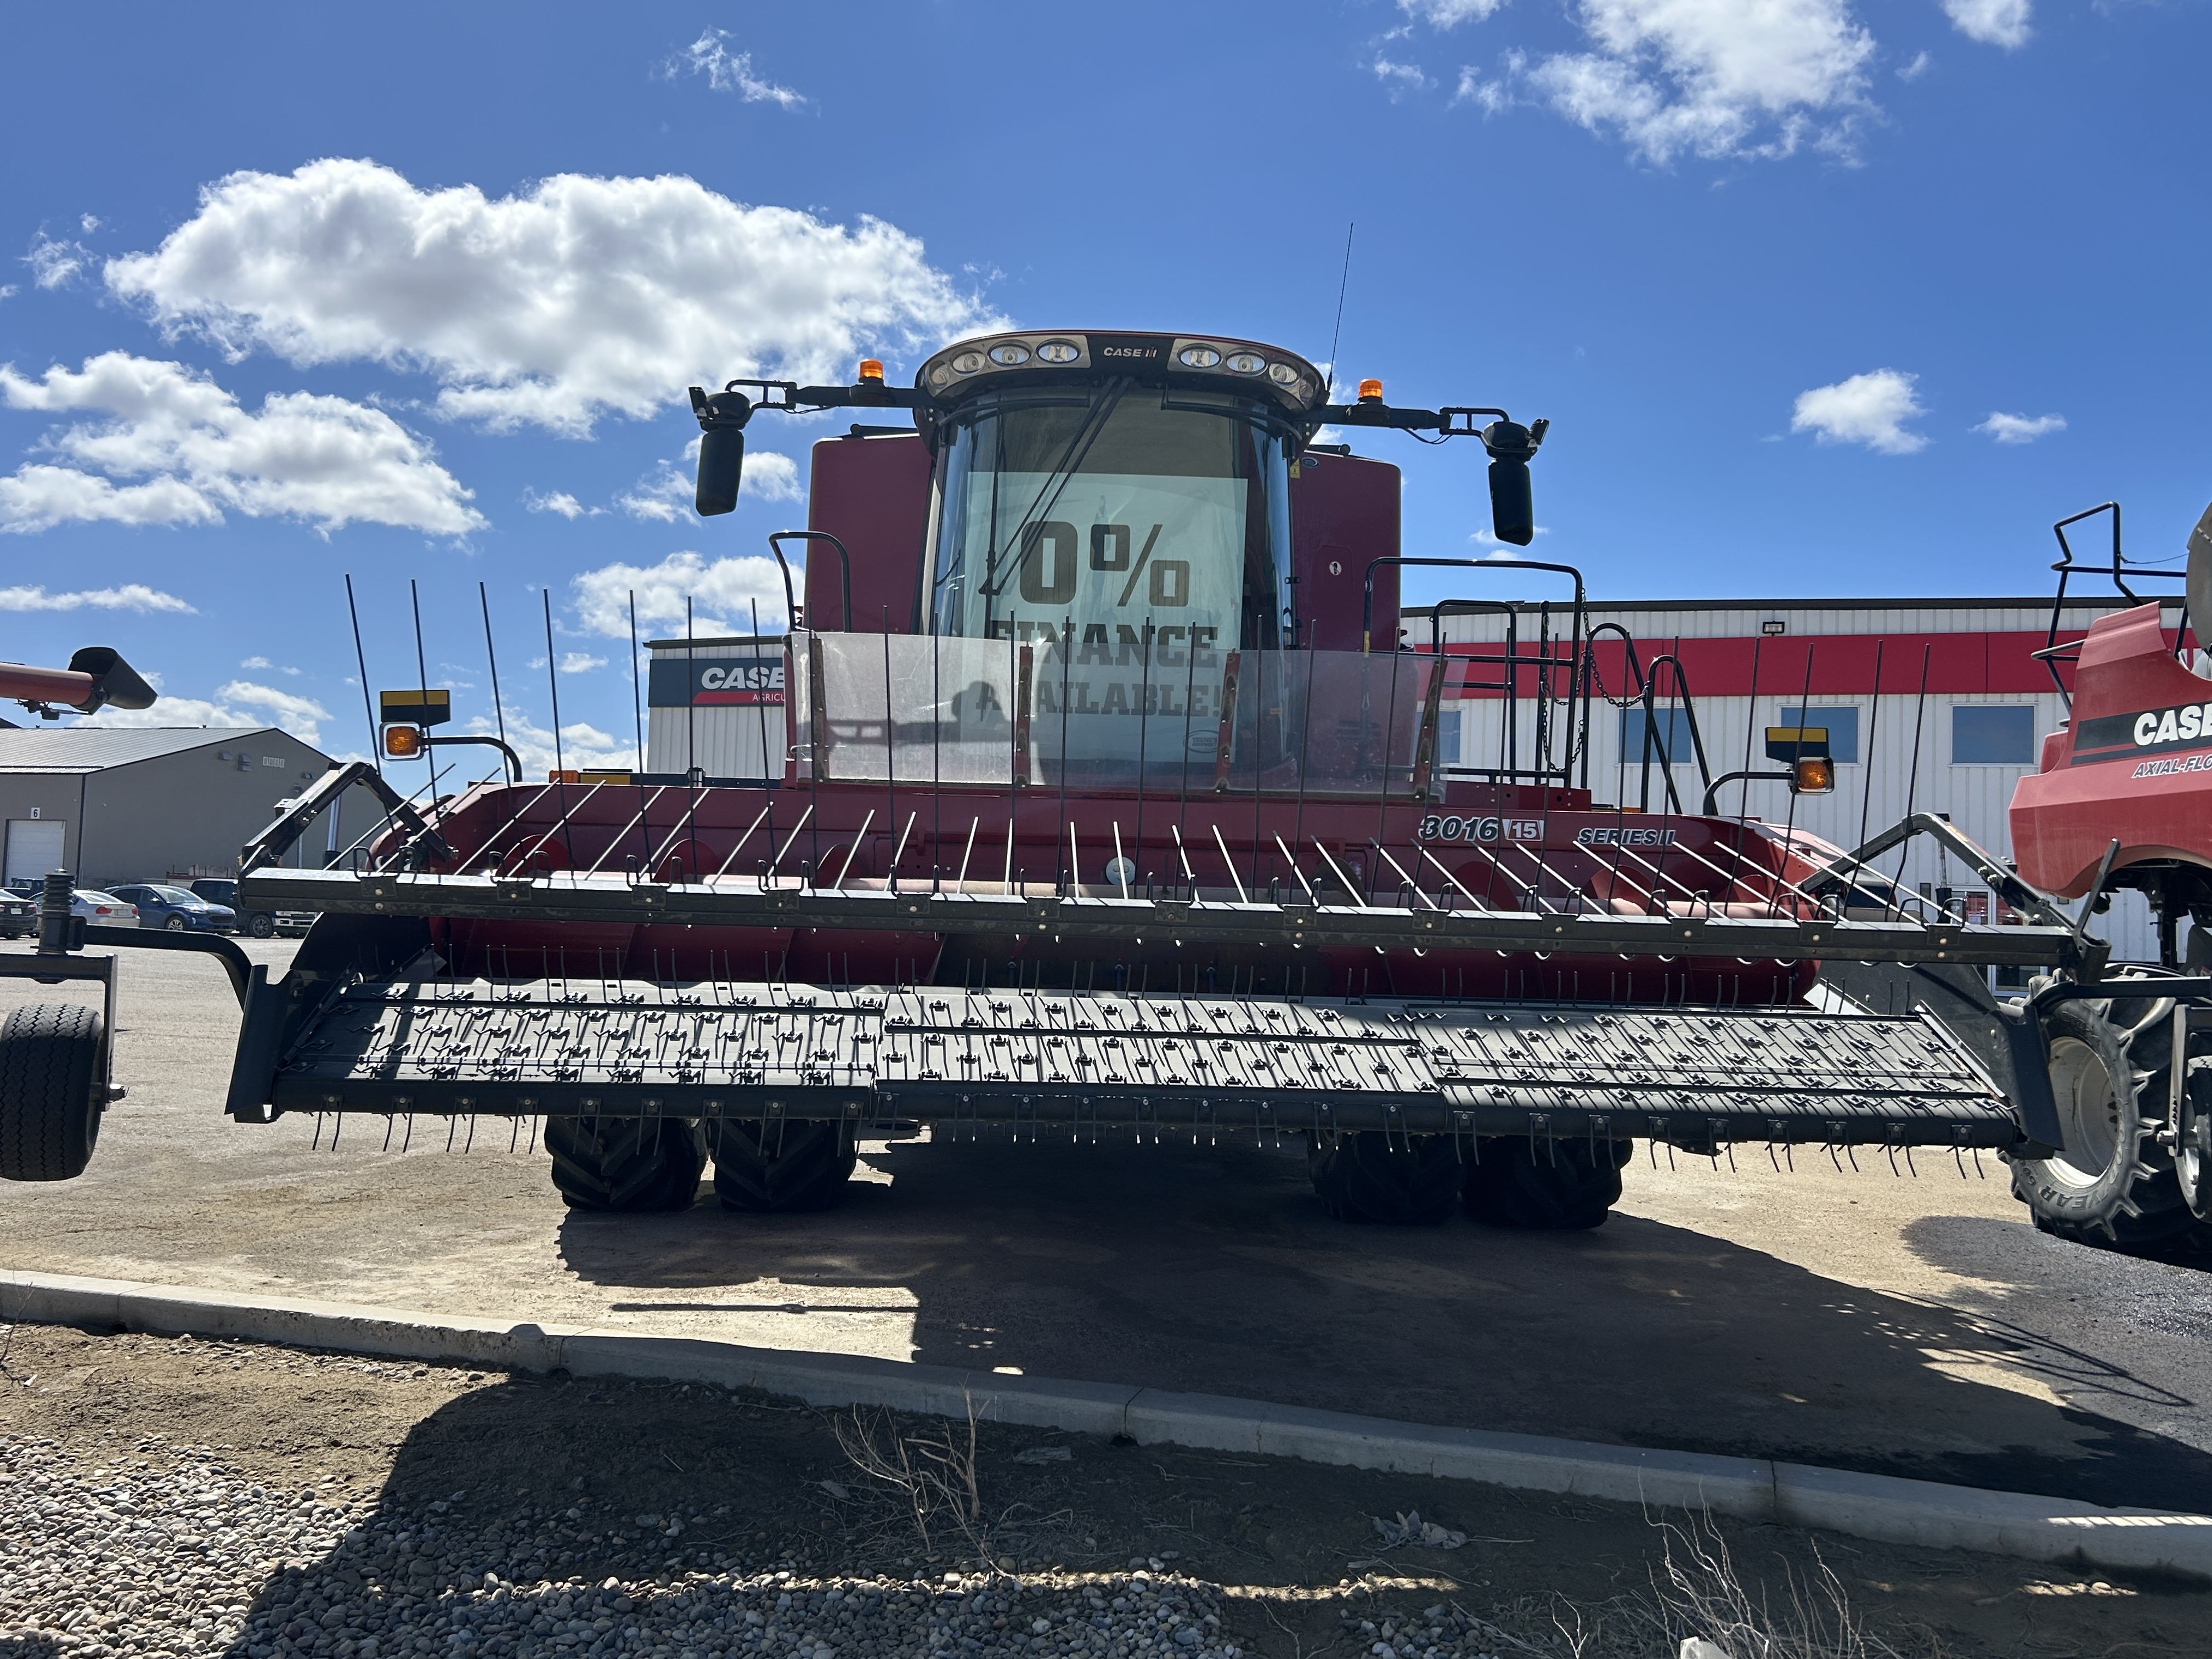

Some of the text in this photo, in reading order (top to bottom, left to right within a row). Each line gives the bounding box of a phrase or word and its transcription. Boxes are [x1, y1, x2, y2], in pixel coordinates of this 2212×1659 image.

[1104, 347, 1142, 357] CASE
[1020, 521, 1190, 607] 0%
[701, 667, 785, 690] CASE
[975, 680, 1220, 718] AAILABLE!
[33, 809, 38, 817] 6
[1418, 815, 1536, 842] 3016 15
[1577, 828, 1658, 845] SERIES
